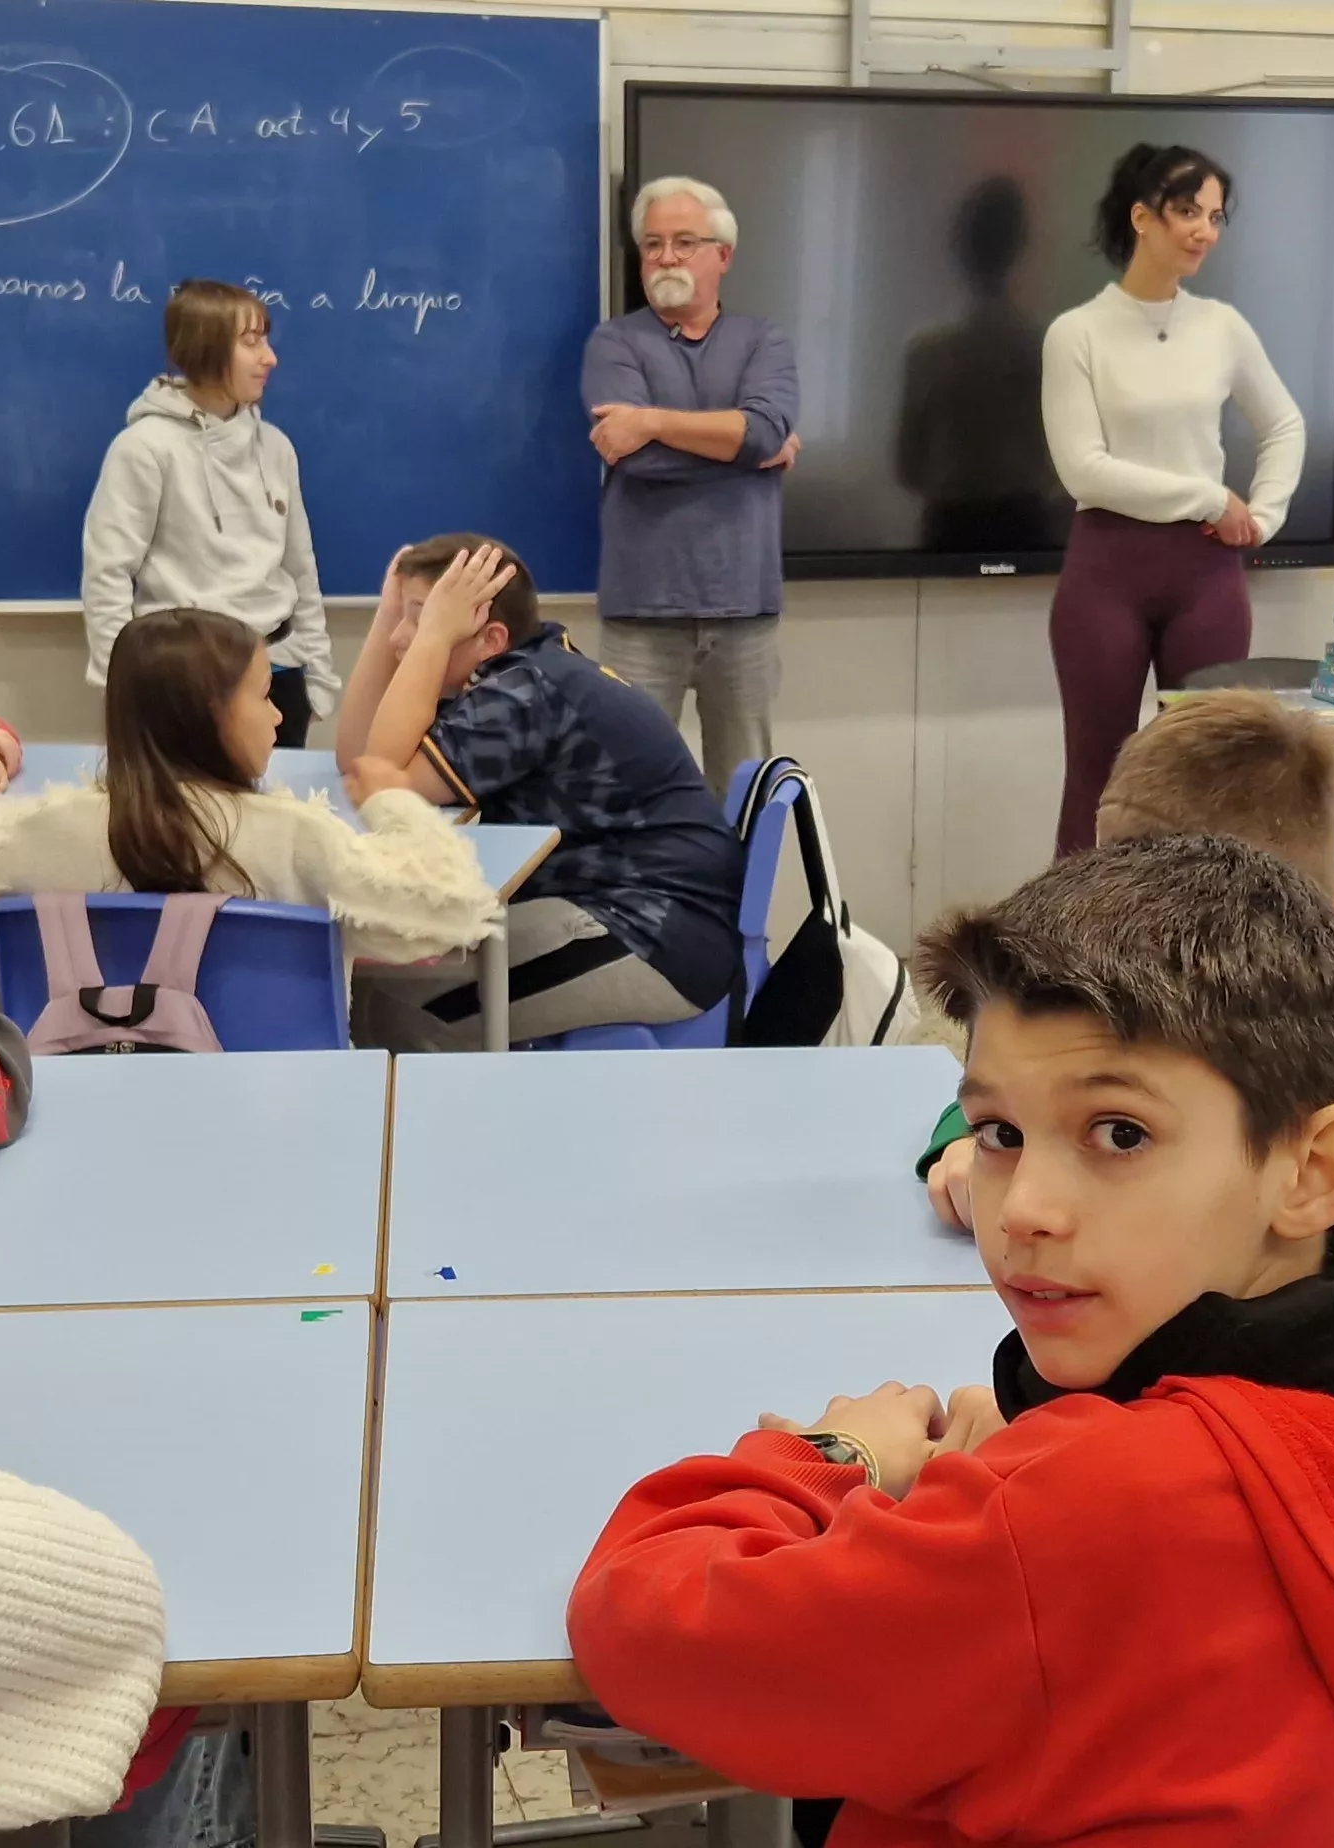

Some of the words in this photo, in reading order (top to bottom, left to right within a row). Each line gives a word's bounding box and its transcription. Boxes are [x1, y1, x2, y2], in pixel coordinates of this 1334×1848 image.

[356, 124, 384, 153] y
[399, 101, 431, 132] 5
[110, 259, 152, 304] la
[310, 292, 334, 311] a
[354, 266, 463, 335] limpio
